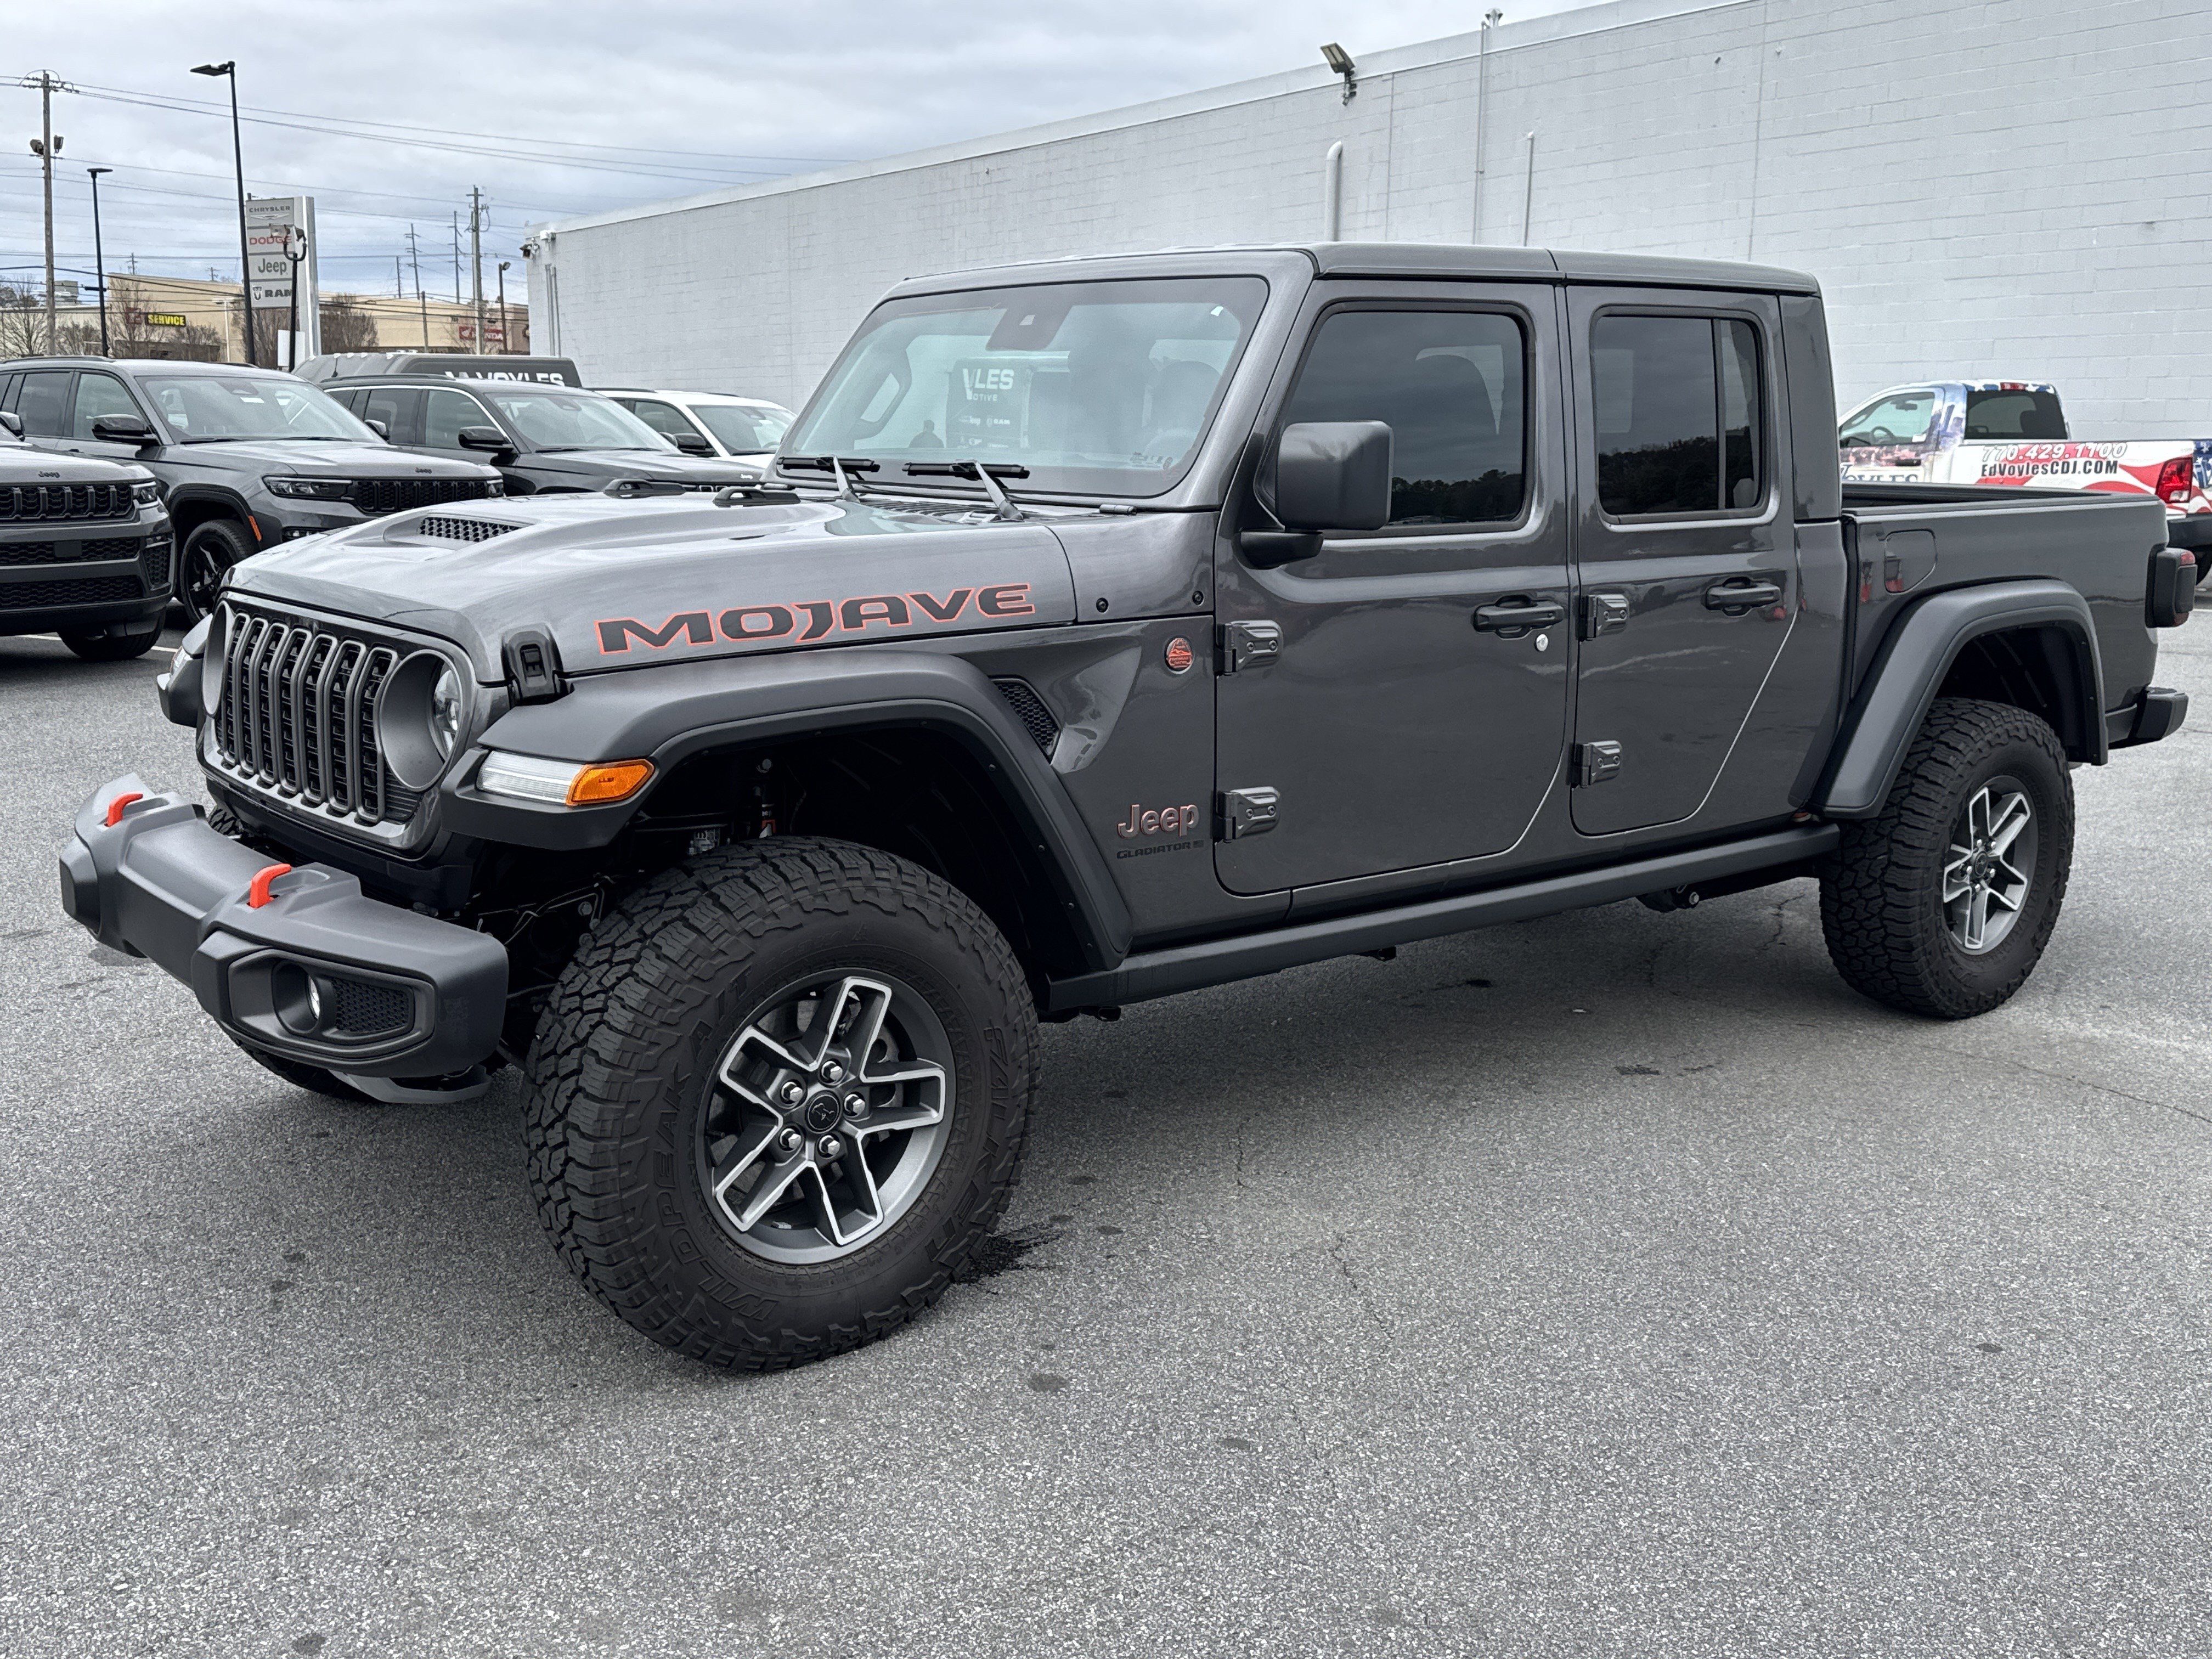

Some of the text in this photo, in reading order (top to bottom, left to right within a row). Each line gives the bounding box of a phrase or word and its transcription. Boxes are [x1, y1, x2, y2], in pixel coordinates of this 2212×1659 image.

[258, 258, 287, 275] Jeep
[148, 313, 185, 325] SERVICE
[1982, 442, 2128, 462] 770.429.1100
[1980, 460, 2119, 477] EdVoylesCDJ.COM
[594, 582, 1036, 655] MOJAVE
[1117, 803, 1200, 839] Jeep
[1116, 841, 1192, 859] GLADIATOR
[653, 1061, 779, 1321] WILDPEAK
